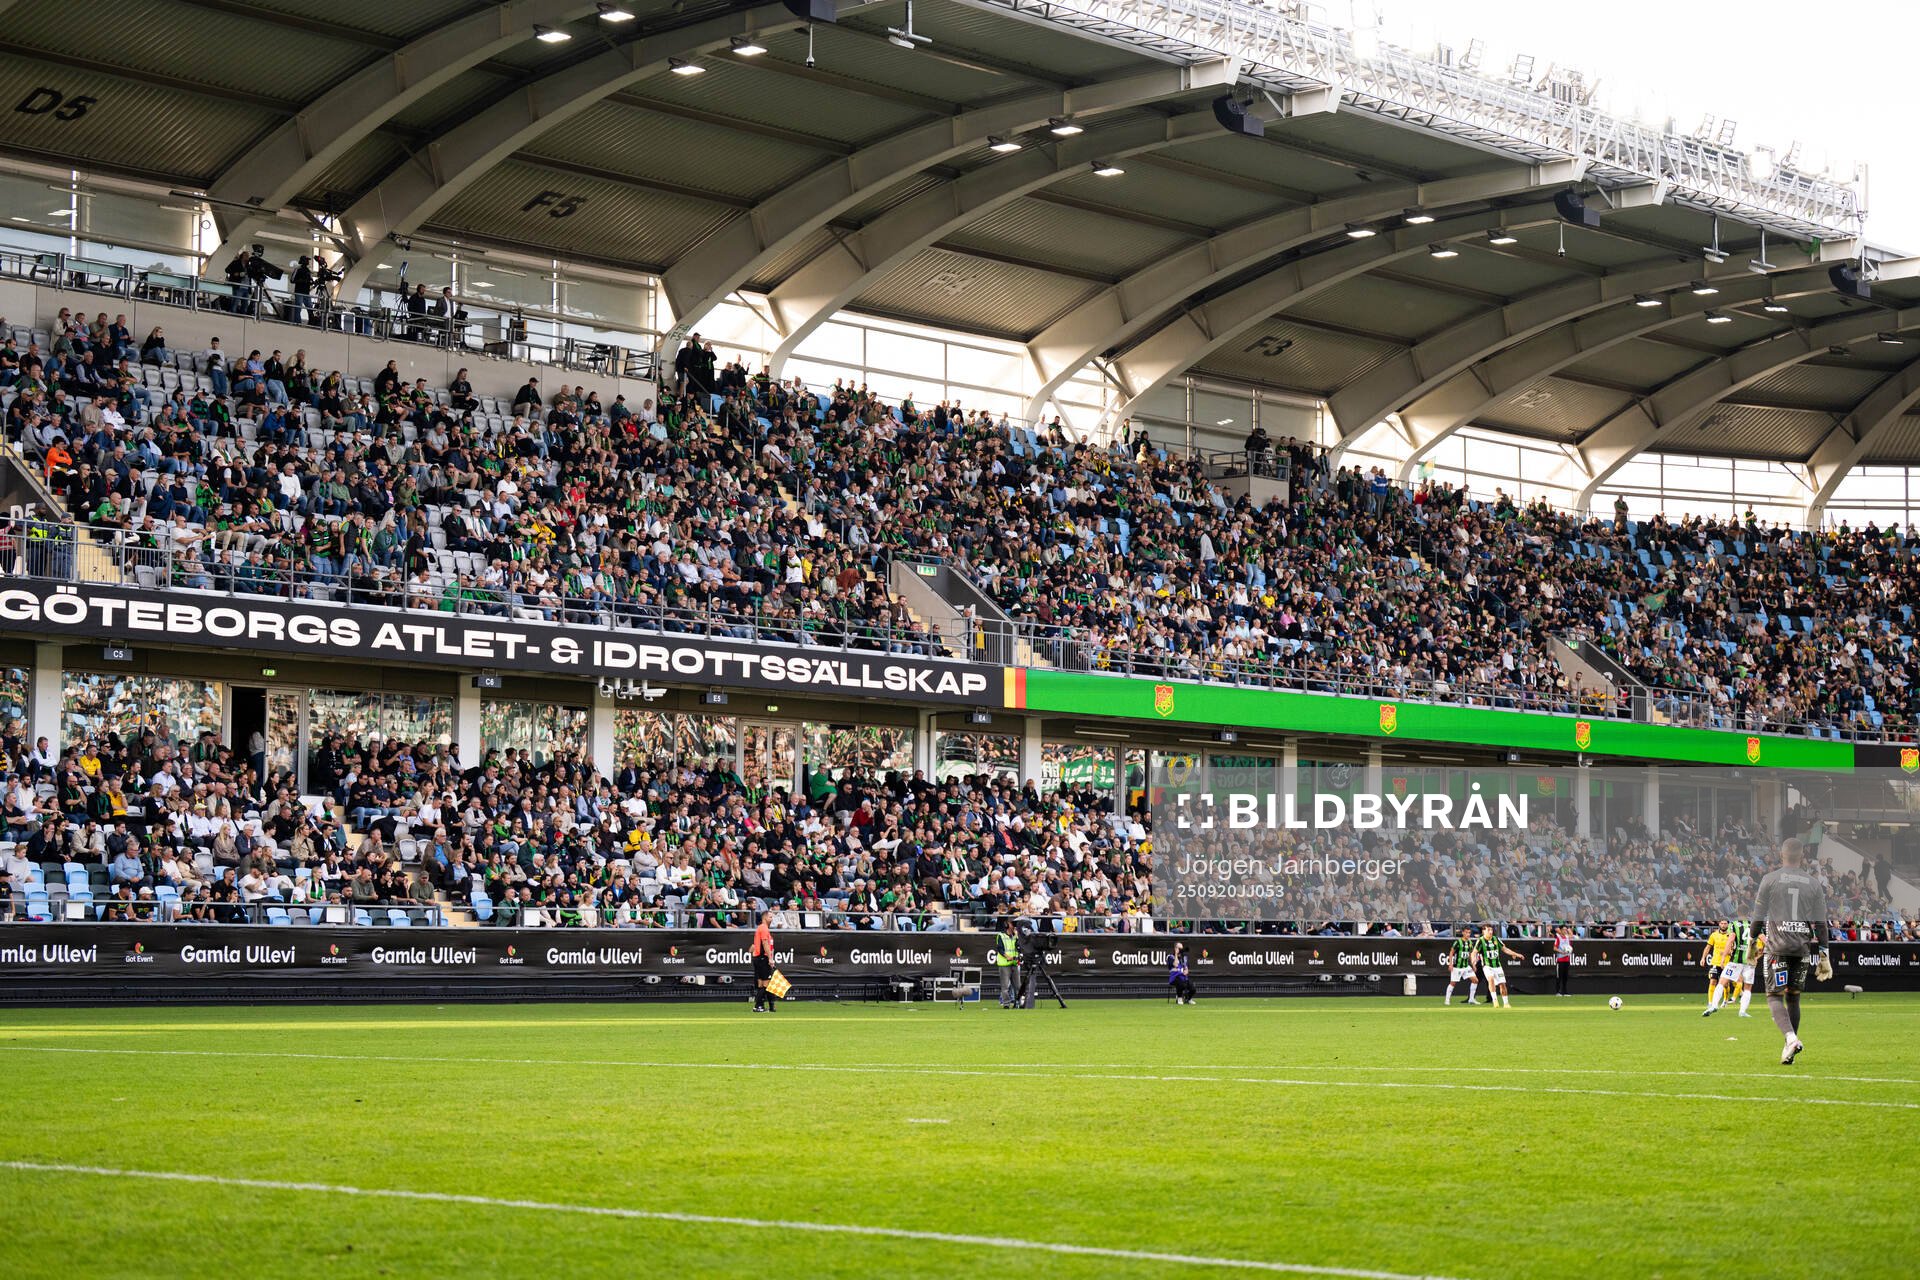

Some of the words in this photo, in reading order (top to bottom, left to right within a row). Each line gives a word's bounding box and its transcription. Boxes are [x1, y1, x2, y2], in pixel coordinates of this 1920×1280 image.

[14, 87, 98, 121] D5
[521, 190, 588, 218] F5
[1244, 335, 1293, 356] F3
[0, 585, 361, 647] GÖTEBORGS
[370, 622, 540, 660] ATLET-
[550, 637, 584, 665] &
[593, 640, 987, 696] IDROTTSSÄLLSKAP
[113, 650, 124, 659] C5
[1787, 887, 1800, 921] 1
[42, 944, 97, 963] Ullevi
[180, 945, 241, 964] Gamla
[246, 945, 296, 964] Ullevi
[371, 946, 426, 965] Gamla
[430, 946, 477, 965] Ullevi
[546, 947, 596, 965] Gamla
[600, 947, 643, 965] Ullevi
[705, 947, 752, 965] Gamla
[850, 948, 893, 965] Gamla
[896, 948, 932, 965] Ullevi
[1111, 950, 1148, 965] Gamla
[1228, 950, 1263, 966] Gamla
[1266, 950, 1295, 966] Ullevi
[1337, 951, 1369, 966] Gamla
[1371, 951, 1399, 966] Ullevi
[1532, 952, 1558, 966] Gaml
[1621, 952, 1649, 966] Gamla
[1650, 952, 1673, 966] Ullevi
[1857, 954, 1880, 966] Gamla
[1881, 954, 1901, 966] Ullevi
